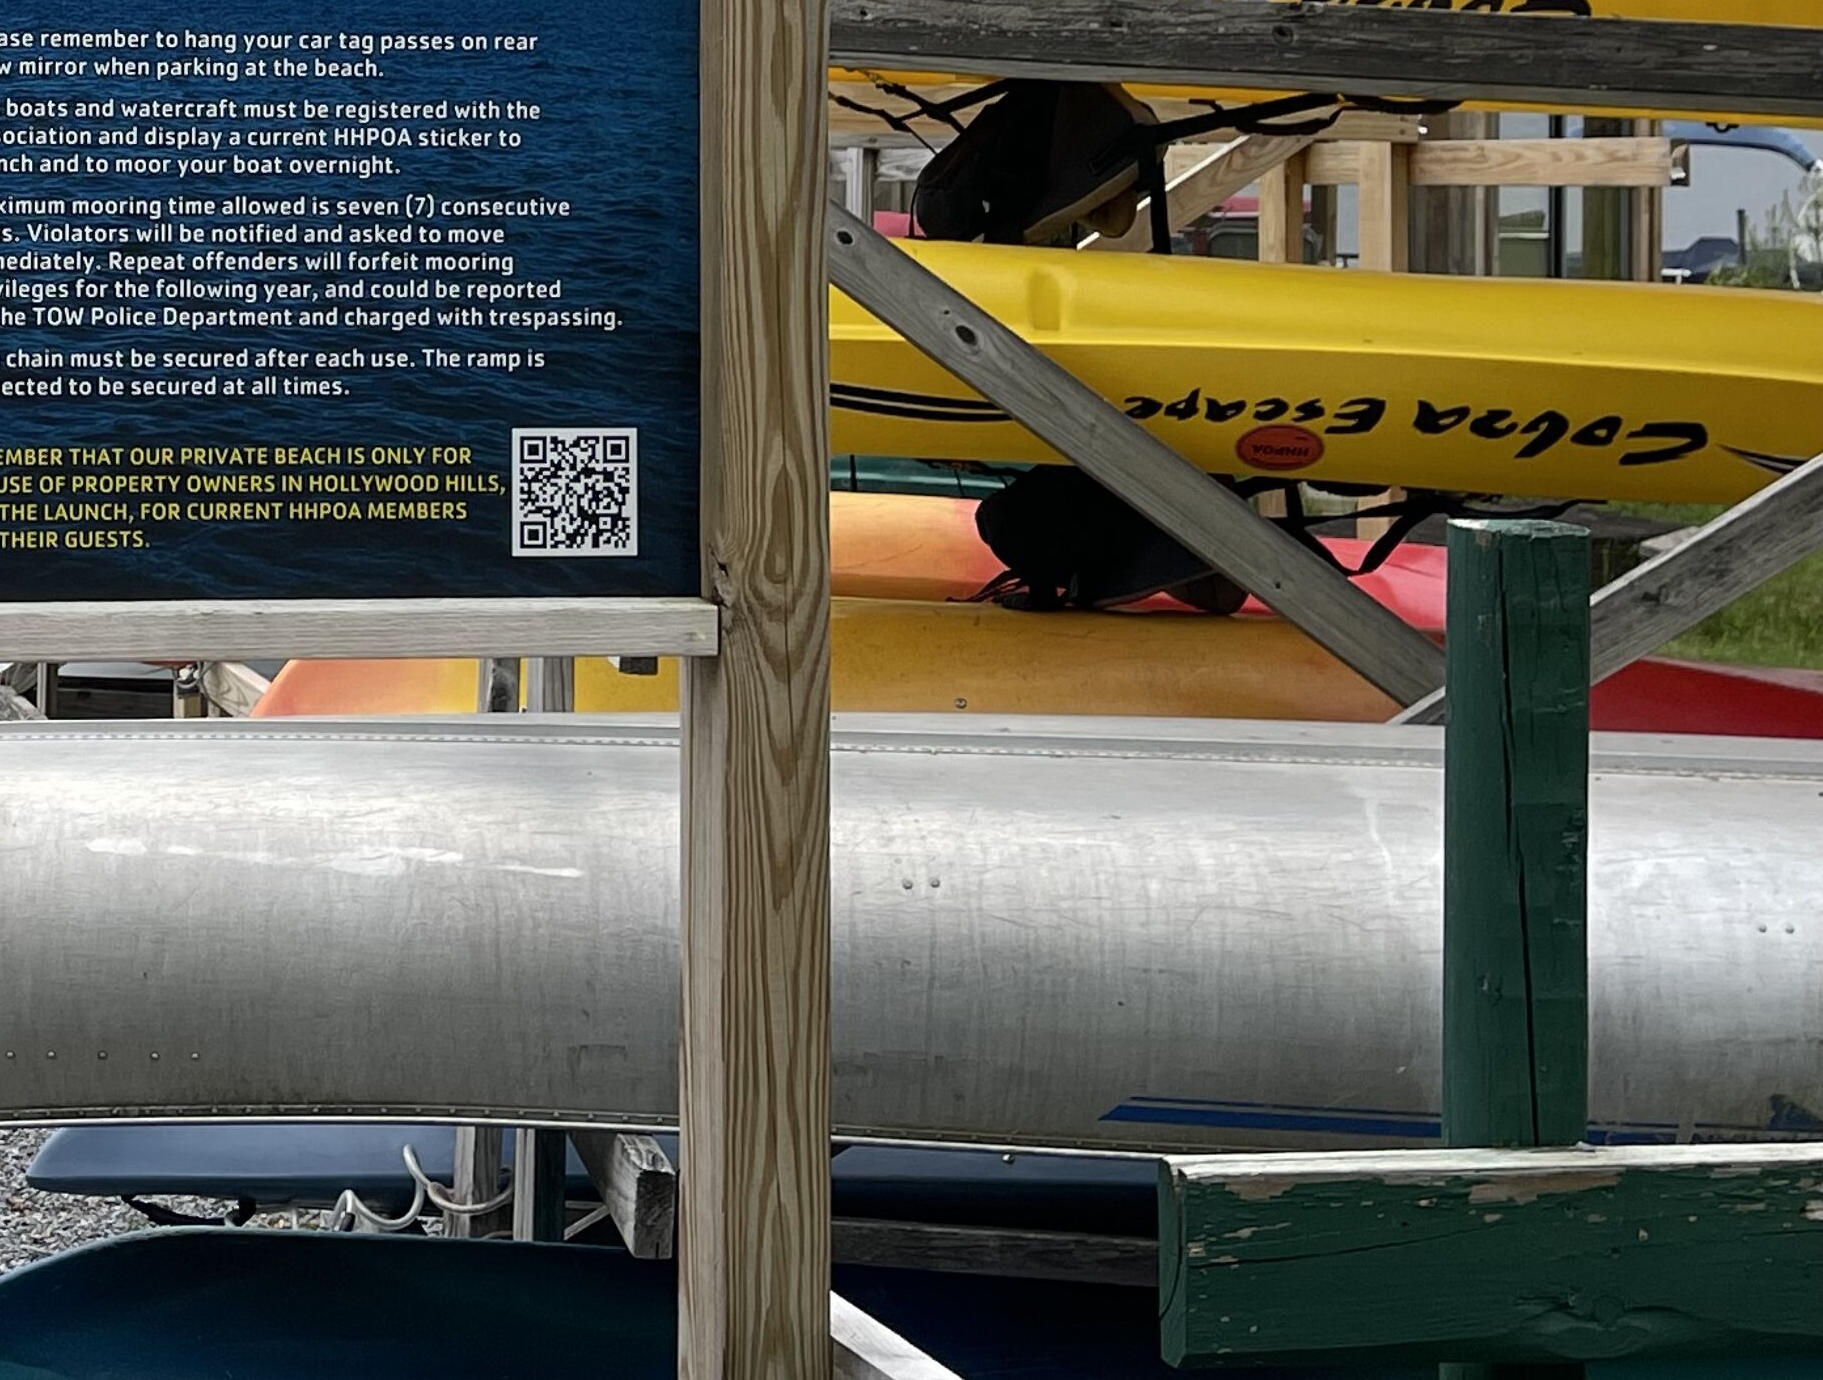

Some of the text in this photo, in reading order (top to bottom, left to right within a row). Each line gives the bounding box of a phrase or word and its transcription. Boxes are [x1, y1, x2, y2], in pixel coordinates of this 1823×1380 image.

[98, 126, 138, 145] and
[144, 126, 223, 151] display
[229, 131, 241, 146] a
[247, 129, 328, 146] current
[334, 127, 413, 147] HHPOA
[418, 127, 493, 147] sticker
[498, 130, 521, 147] to
[72, 196, 161, 220] mooring
[168, 196, 216, 215] time
[221, 195, 305, 215] allowed
[312, 196, 330, 215] is
[336, 201, 399, 216] seven
[406, 193, 435, 218] (7)
[441, 197, 570, 216] consecutive
[109, 251, 185, 275] Repeat
[192, 250, 298, 271] offenders
[305, 251, 341, 271] will
[348, 251, 419, 271] forfeit
[425, 252, 514, 276] mooring
[32, 306, 84, 326] TOW
[91, 306, 156, 326] Police
[163, 307, 293, 331] Department
[298, 307, 338, 326] and
[344, 307, 430, 331] charged
[436, 307, 483, 326] with
[489, 307, 622, 331] trespassing.
[68, 378, 92, 396] to
[98, 376, 124, 395] be
[131, 376, 216, 395] secured
[222, 378, 245, 395] at
[251, 376, 277, 395] all
[283, 376, 350, 395] times.
[1124, 387, 1709, 466] Cobra Escape
[69, 448, 124, 465] THAT
[130, 447, 173, 465] OUR
[181, 447, 267, 465] PRIVATE
[275, 447, 340, 464] BEACH
[348, 447, 365, 464] IS
[371, 447, 426, 465] ONLY
[432, 447, 471, 464] FOR
[44, 503, 134, 523] LAUNCH,
[141, 503, 180, 520] FOR
[187, 503, 283, 520] CURRENT
[289, 502, 362, 519] HHPOA
[368, 502, 467, 519] MEMBERS
[65, 530, 151, 548] GUESTS.
